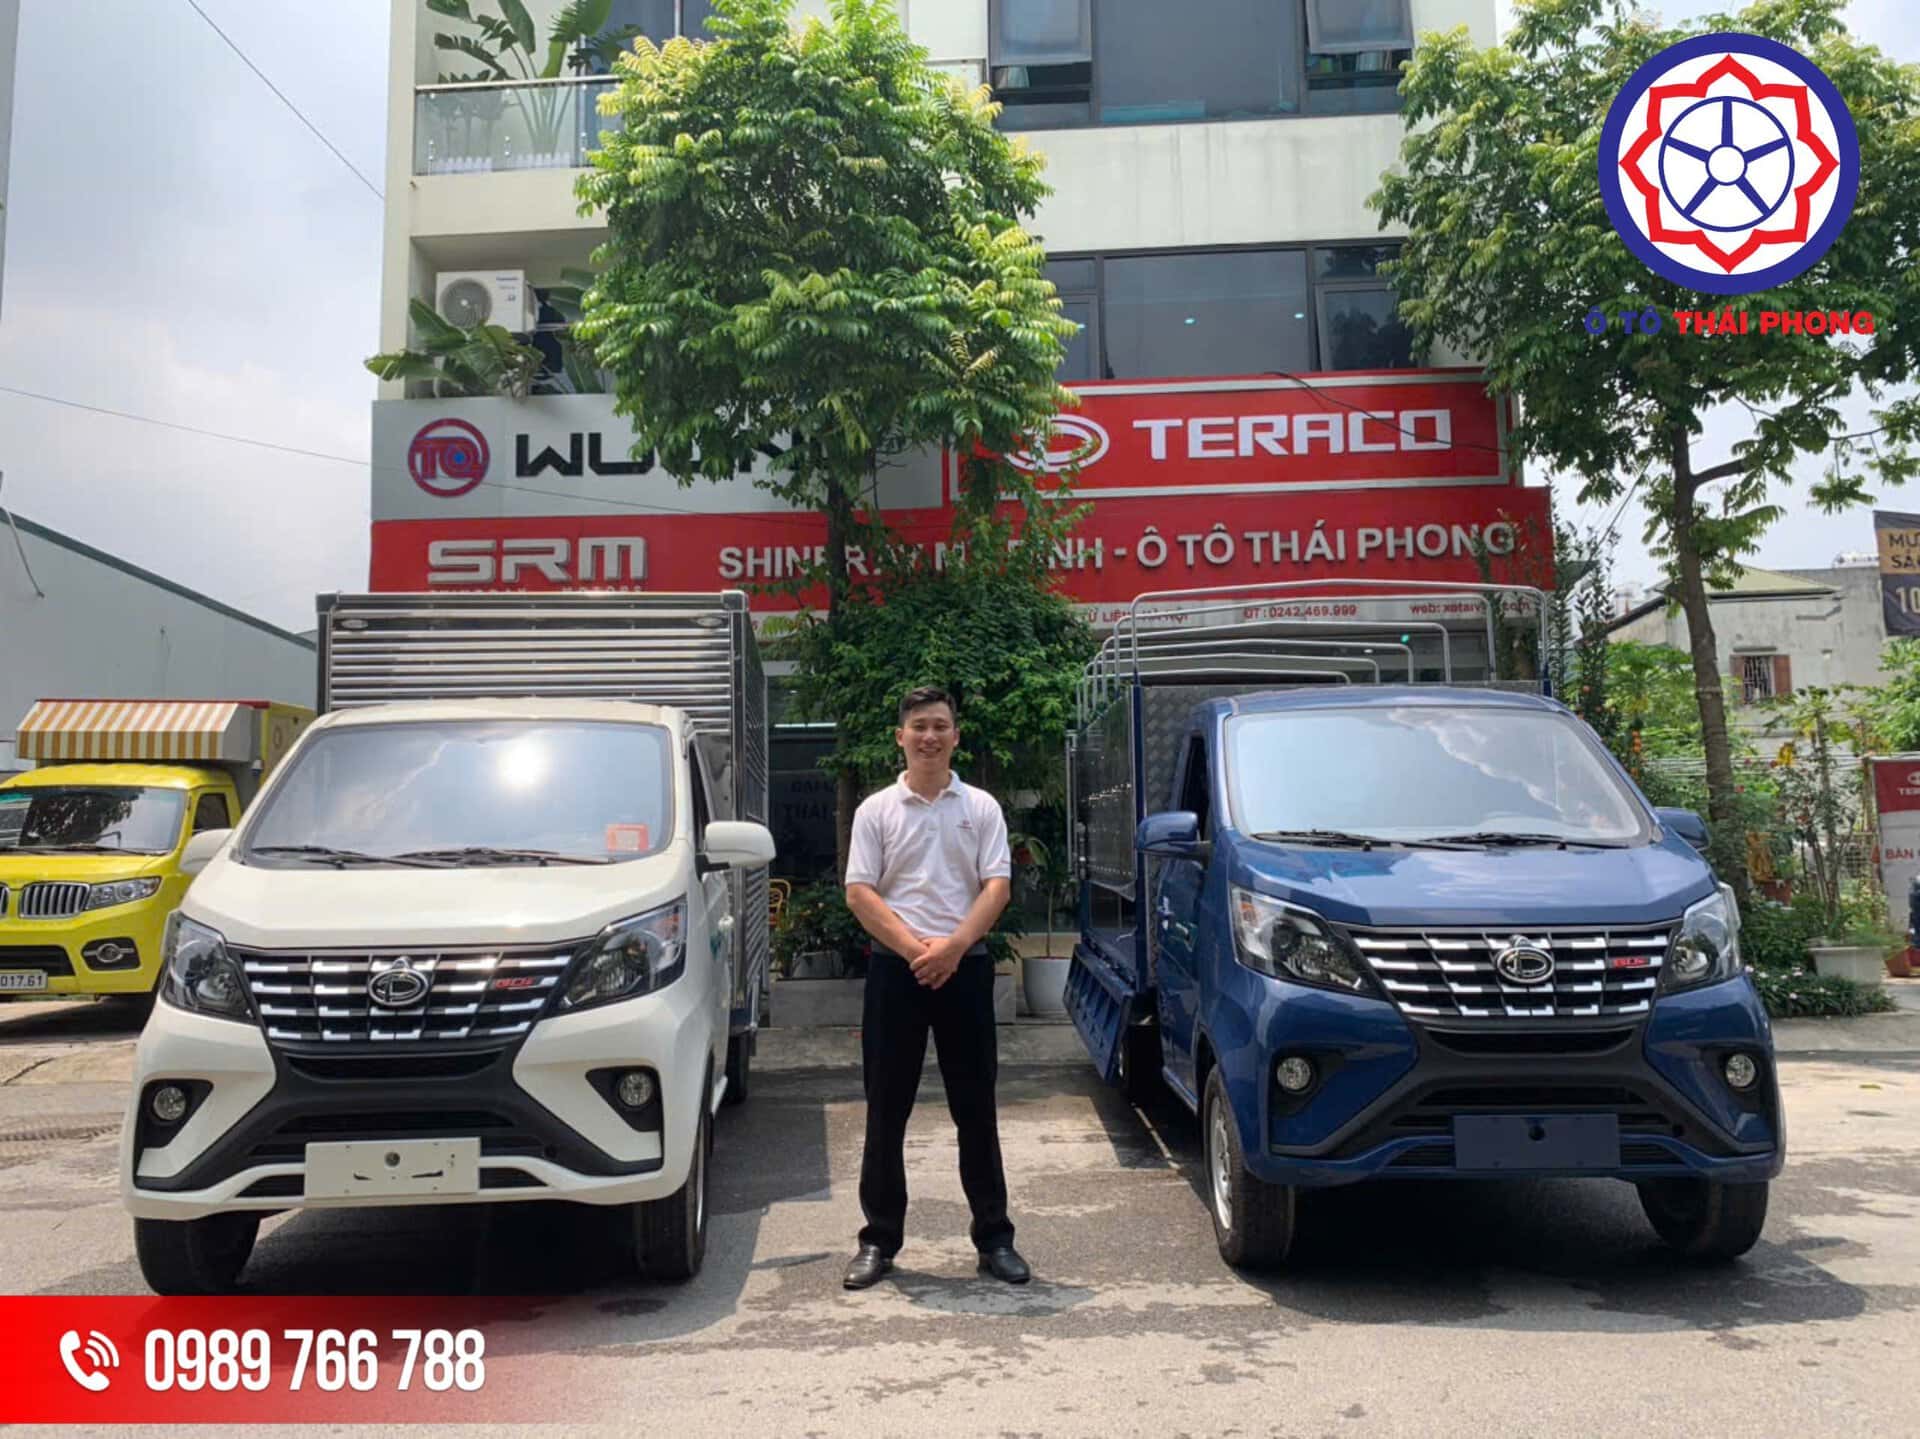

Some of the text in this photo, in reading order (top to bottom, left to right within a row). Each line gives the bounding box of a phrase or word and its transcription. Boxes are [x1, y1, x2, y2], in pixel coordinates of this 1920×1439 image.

[1132, 408, 1451, 460] TERACO
[428, 536, 648, 585] SRM
[1136, 526, 1168, 568] Ô
[1177, 523, 1236, 567] TÔ
[1244, 519, 1347, 563] THÁI
[1357, 521, 1517, 560] PHONG
